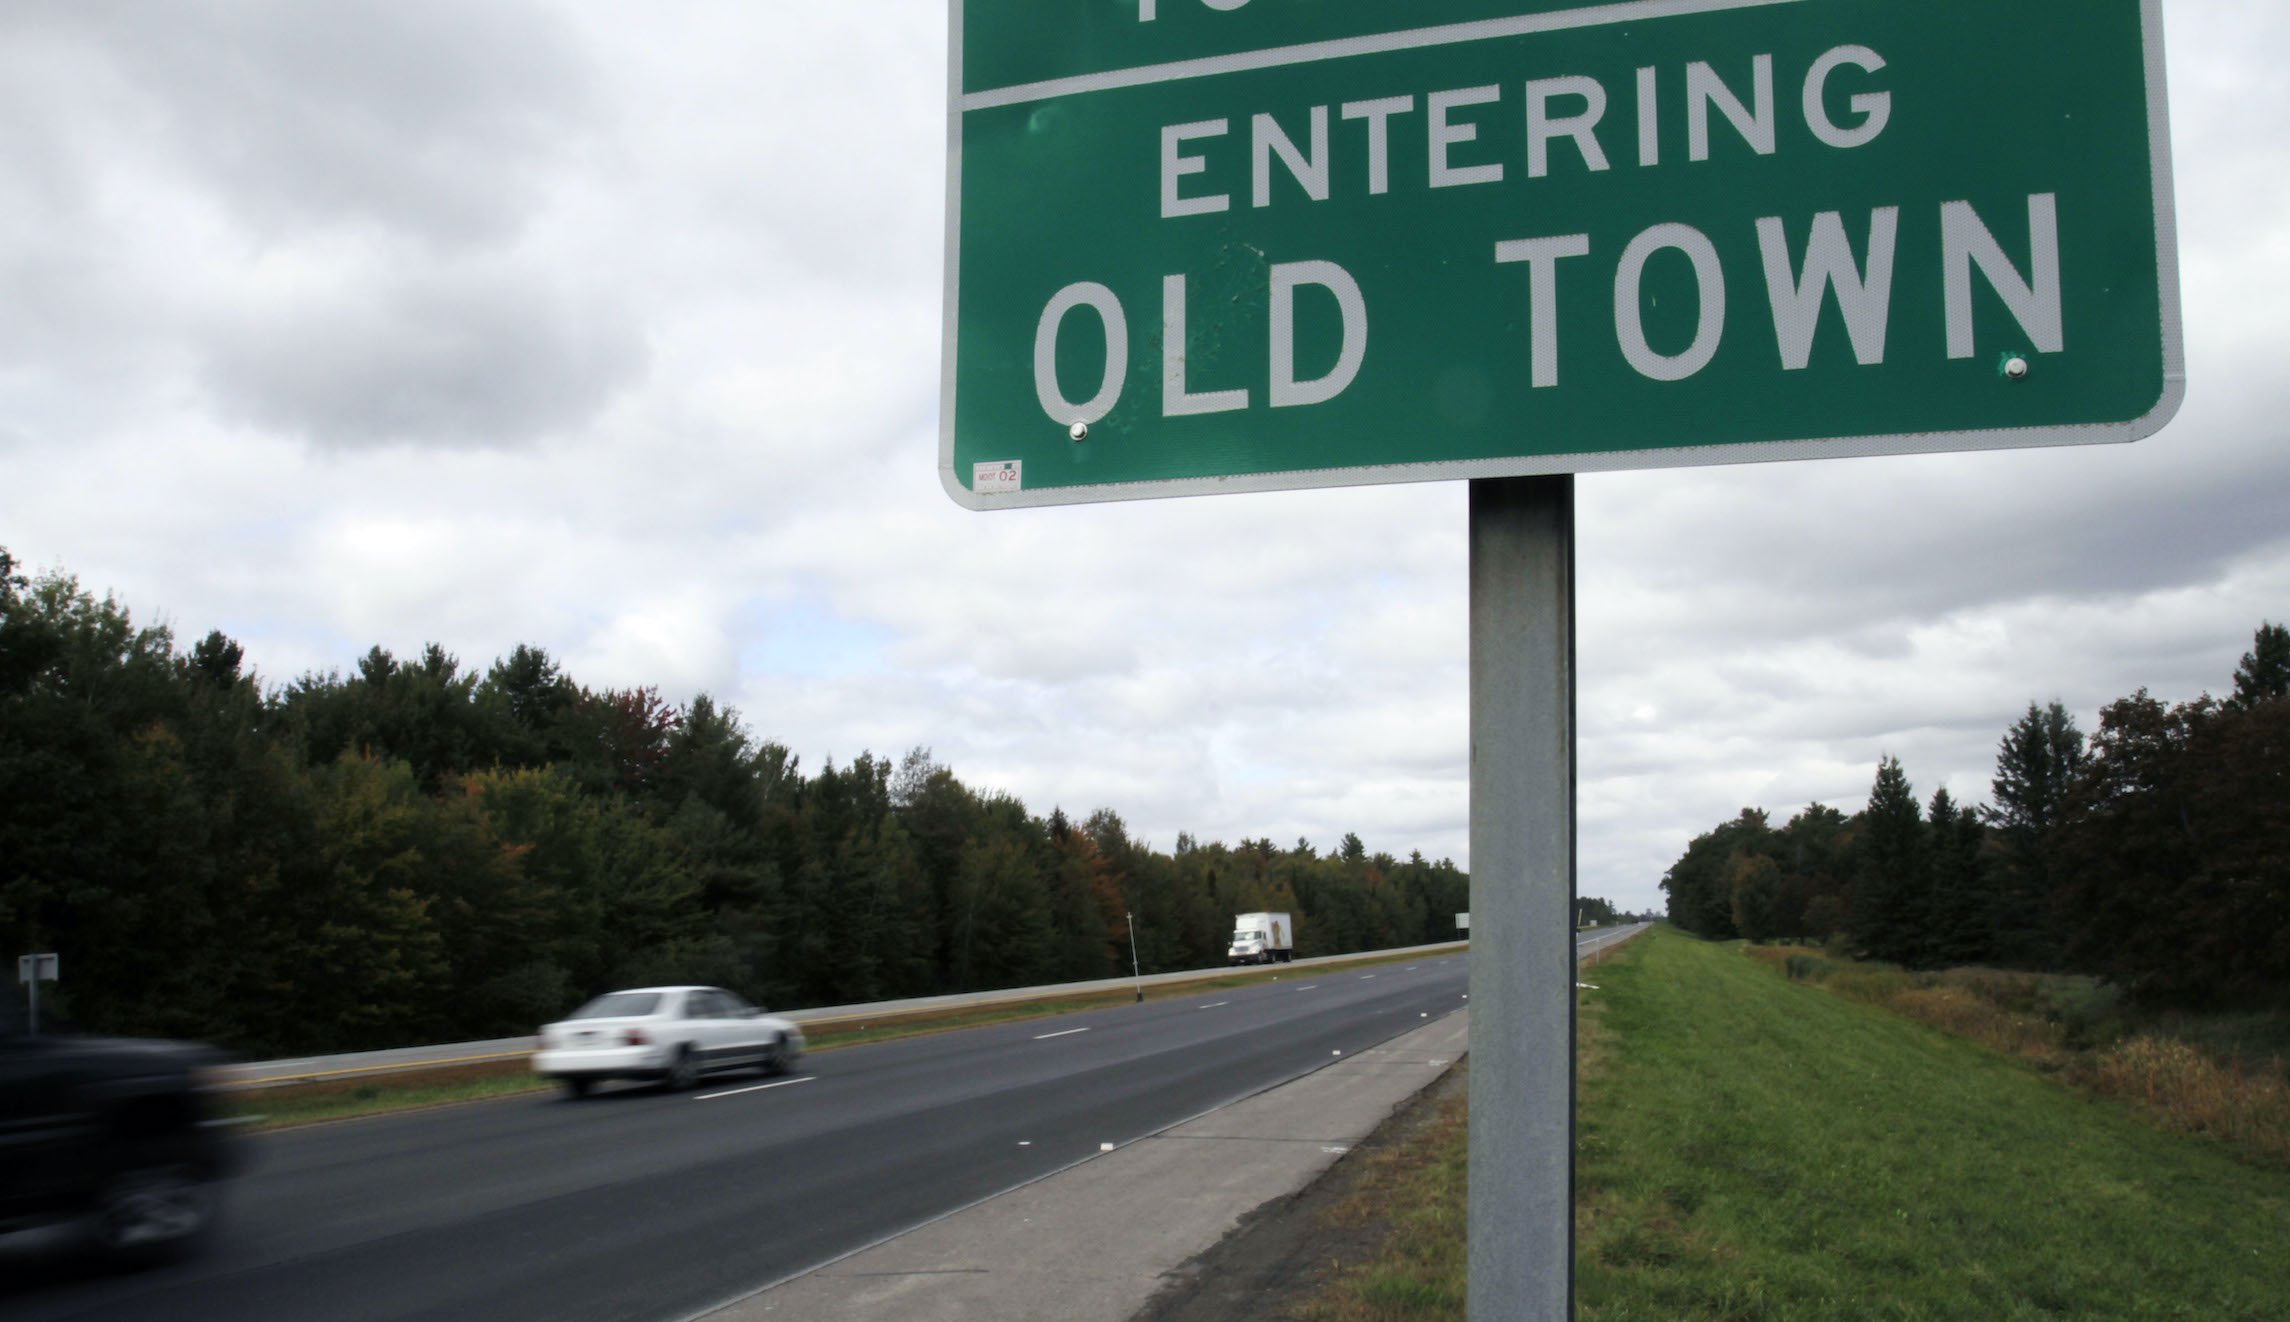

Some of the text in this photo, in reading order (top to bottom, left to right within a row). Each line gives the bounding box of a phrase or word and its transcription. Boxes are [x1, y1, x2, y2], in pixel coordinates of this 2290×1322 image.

[1160, 45, 1892, 219] ENTERING
[1034, 193, 2063, 427] OLD TOWN
[999, 470, 1017, 481] 02
